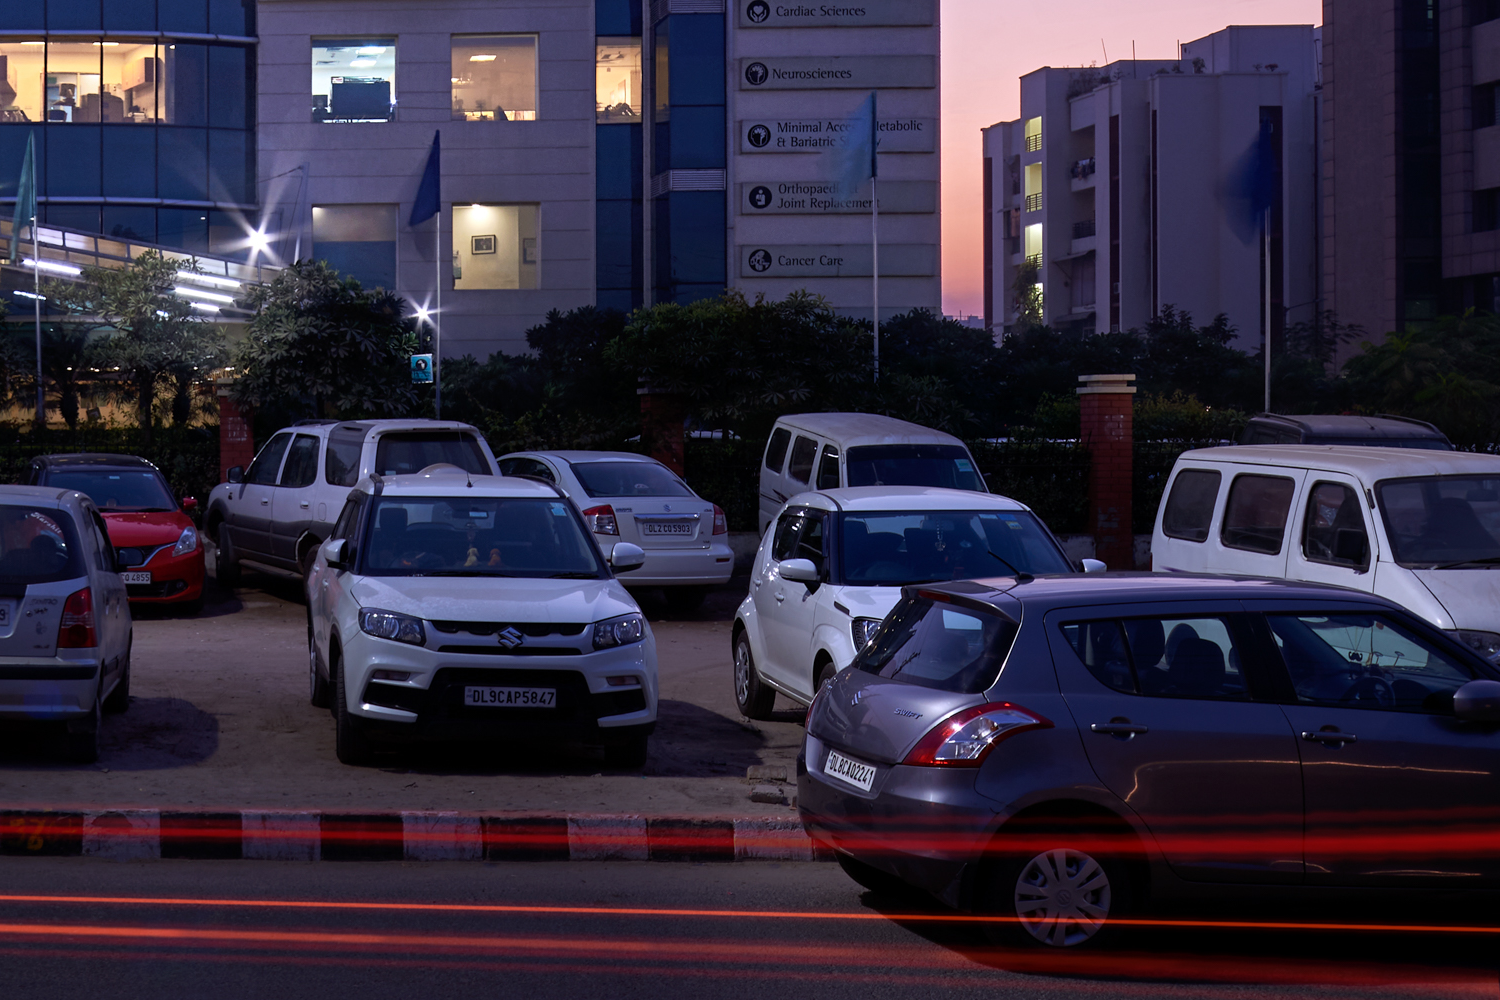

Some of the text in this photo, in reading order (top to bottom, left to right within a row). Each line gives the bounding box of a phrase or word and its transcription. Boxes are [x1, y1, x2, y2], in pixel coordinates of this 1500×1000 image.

[775, 5, 866, 17] Cardiac Sciences
[772, 68, 852, 80] Neurosciences
[777, 121, 822, 133] Minimal
[874, 120, 923, 132] etabolic
[776, 137, 786, 148] &
[790, 136, 835, 148] Bariatric
[777, 198, 805, 209] Joint
[778, 255, 844, 267] Cancer Care
[473, 689, 555, 705] DL9CAP5847
[894, 707, 923, 720] SWIFT
